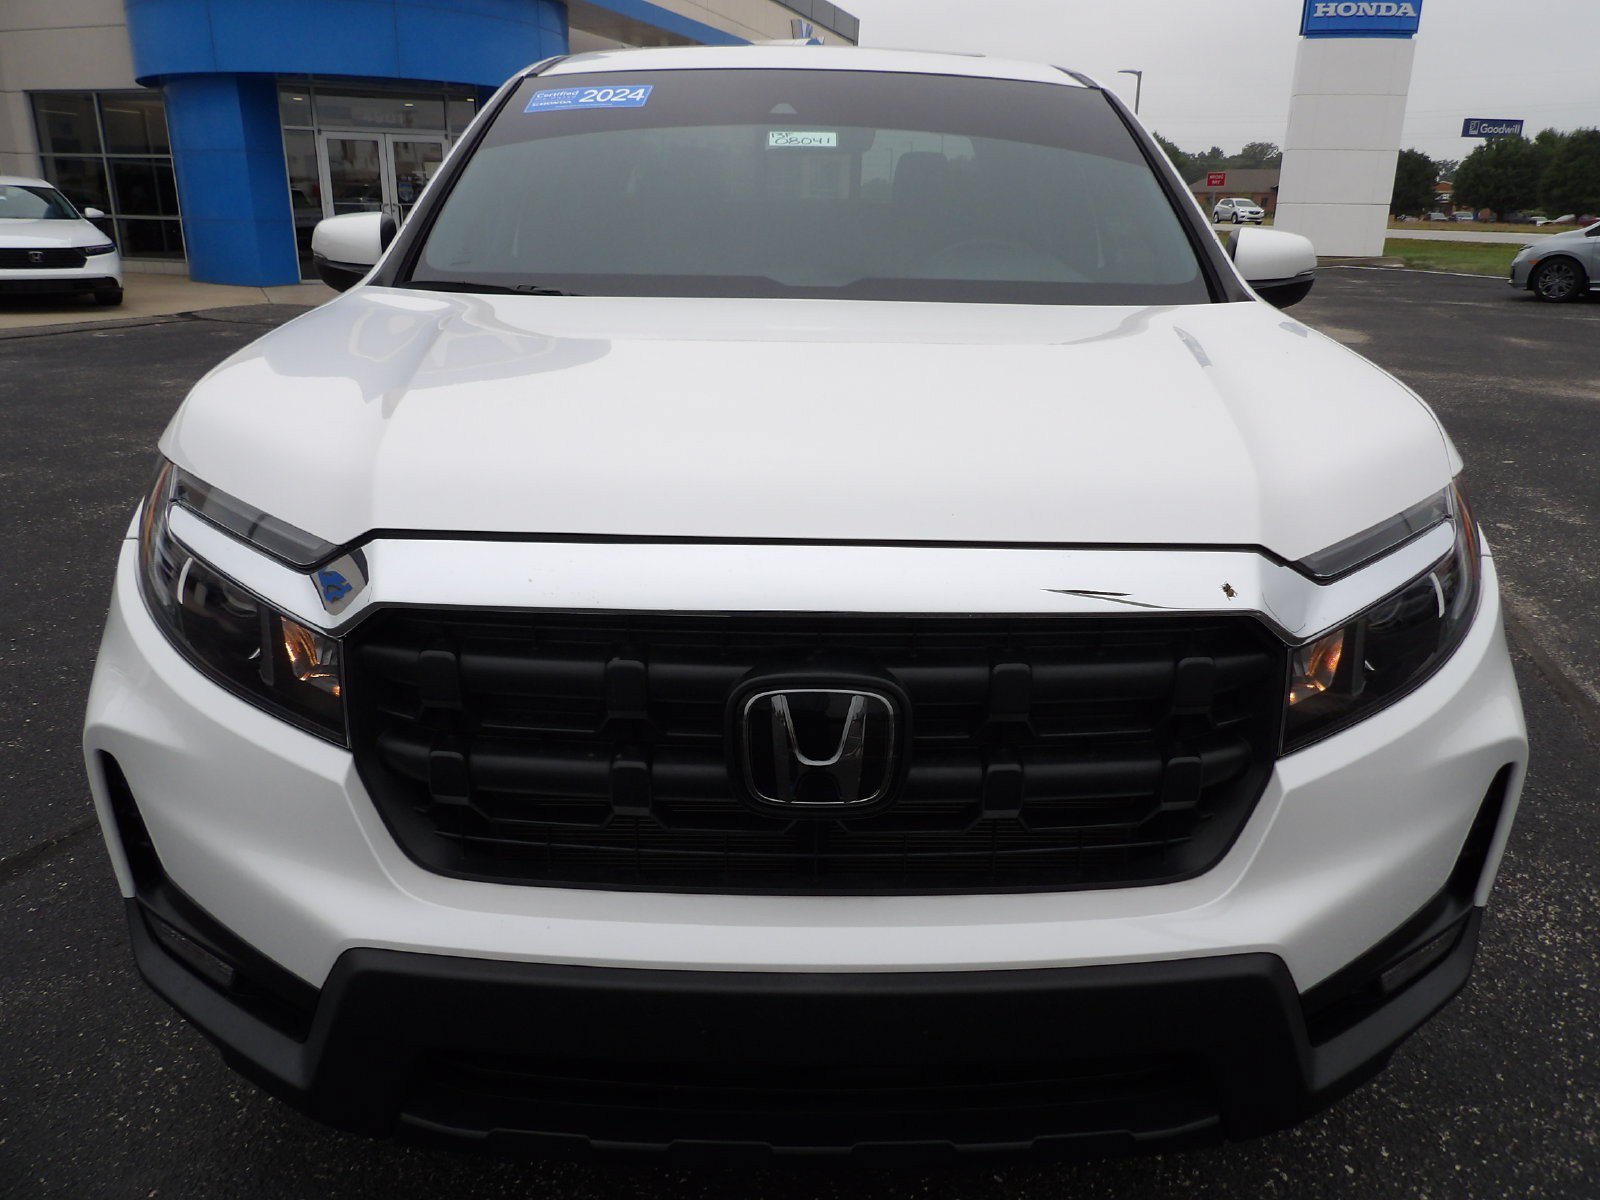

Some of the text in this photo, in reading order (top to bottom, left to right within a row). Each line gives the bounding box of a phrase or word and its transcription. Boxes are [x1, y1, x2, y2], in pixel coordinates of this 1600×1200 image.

[1313, 2, 1417, 17] HONDA
[536, 90, 580, 99] Certified
[579, 88, 646, 103] 2024
[1480, 123, 1521, 134] Goodwill
